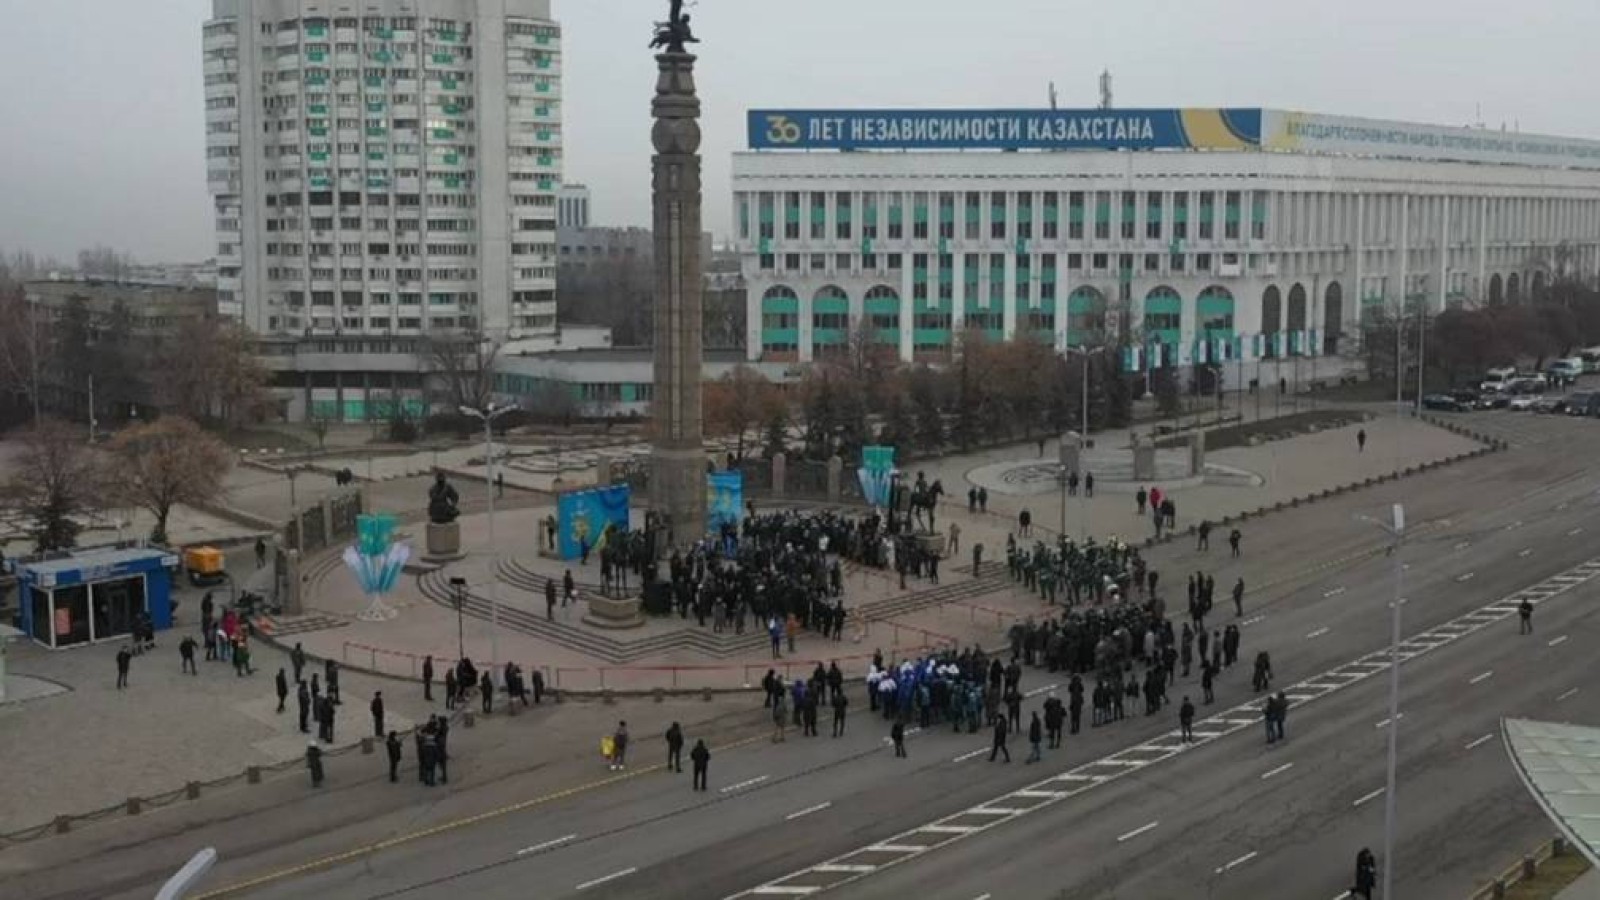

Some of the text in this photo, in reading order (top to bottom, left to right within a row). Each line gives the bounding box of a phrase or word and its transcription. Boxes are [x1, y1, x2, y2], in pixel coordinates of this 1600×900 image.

[766, 115, 1154, 143] 30 ЛЕТ НЕЗАВИСИМОСТИ КАЗАХСТАНА
